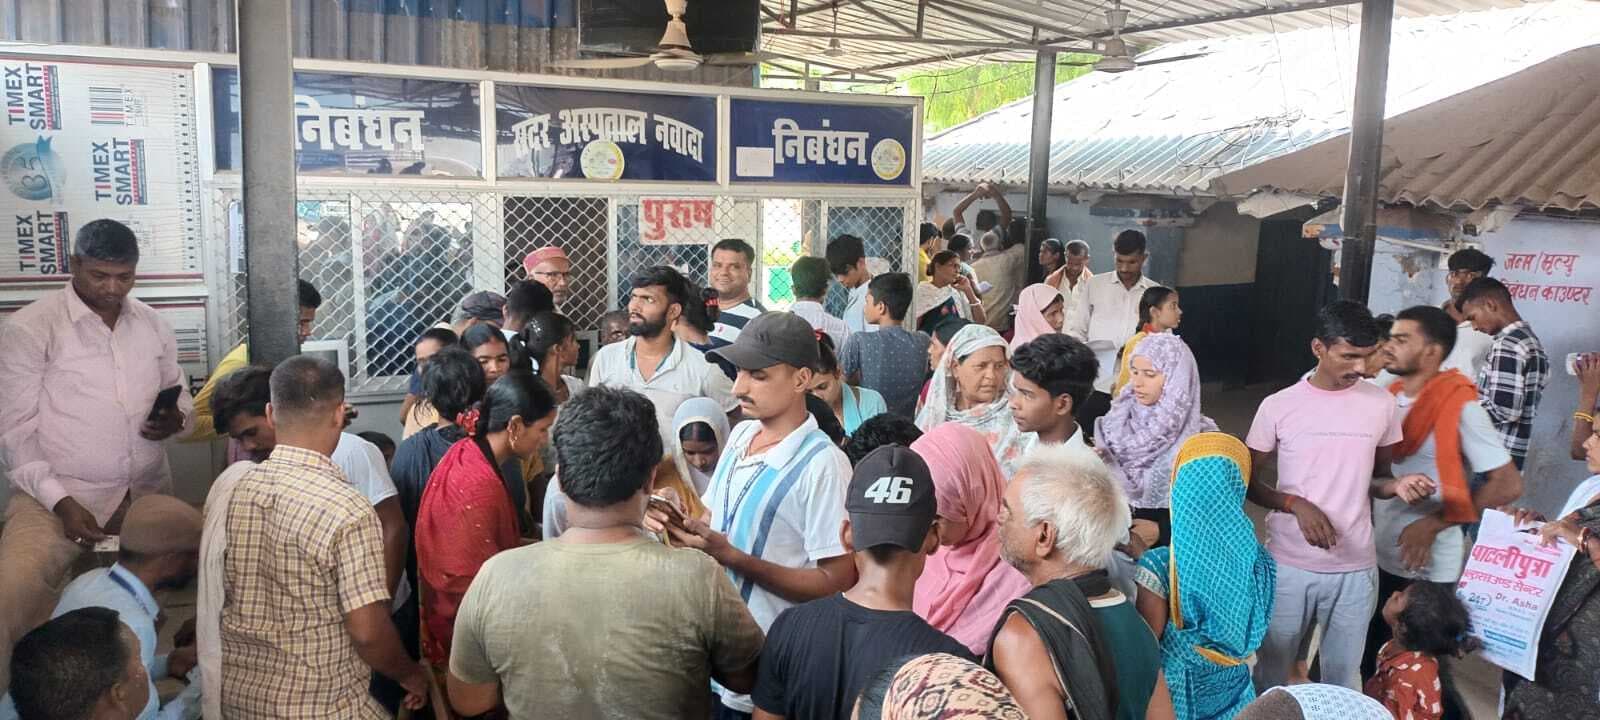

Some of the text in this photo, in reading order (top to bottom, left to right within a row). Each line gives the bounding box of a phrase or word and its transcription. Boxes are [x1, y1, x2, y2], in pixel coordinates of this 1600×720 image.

[5, 66, 25, 125] TIMEX
[26, 63, 46, 130] SMART
[512, 113, 551, 158] सदर
[559, 107, 648, 145] अस्पताल
[653, 114, 704, 163] नवादा
[772, 118, 869, 165] निबंधन
[92, 142, 112, 201] TIMEX
[113, 138, 133, 205] SMART
[16, 215, 36, 272] TIMEX
[37, 210, 57, 274] SMART
[864, 476, 914, 504] 46
[1495, 592, 1538, 611] Dr. Asha
